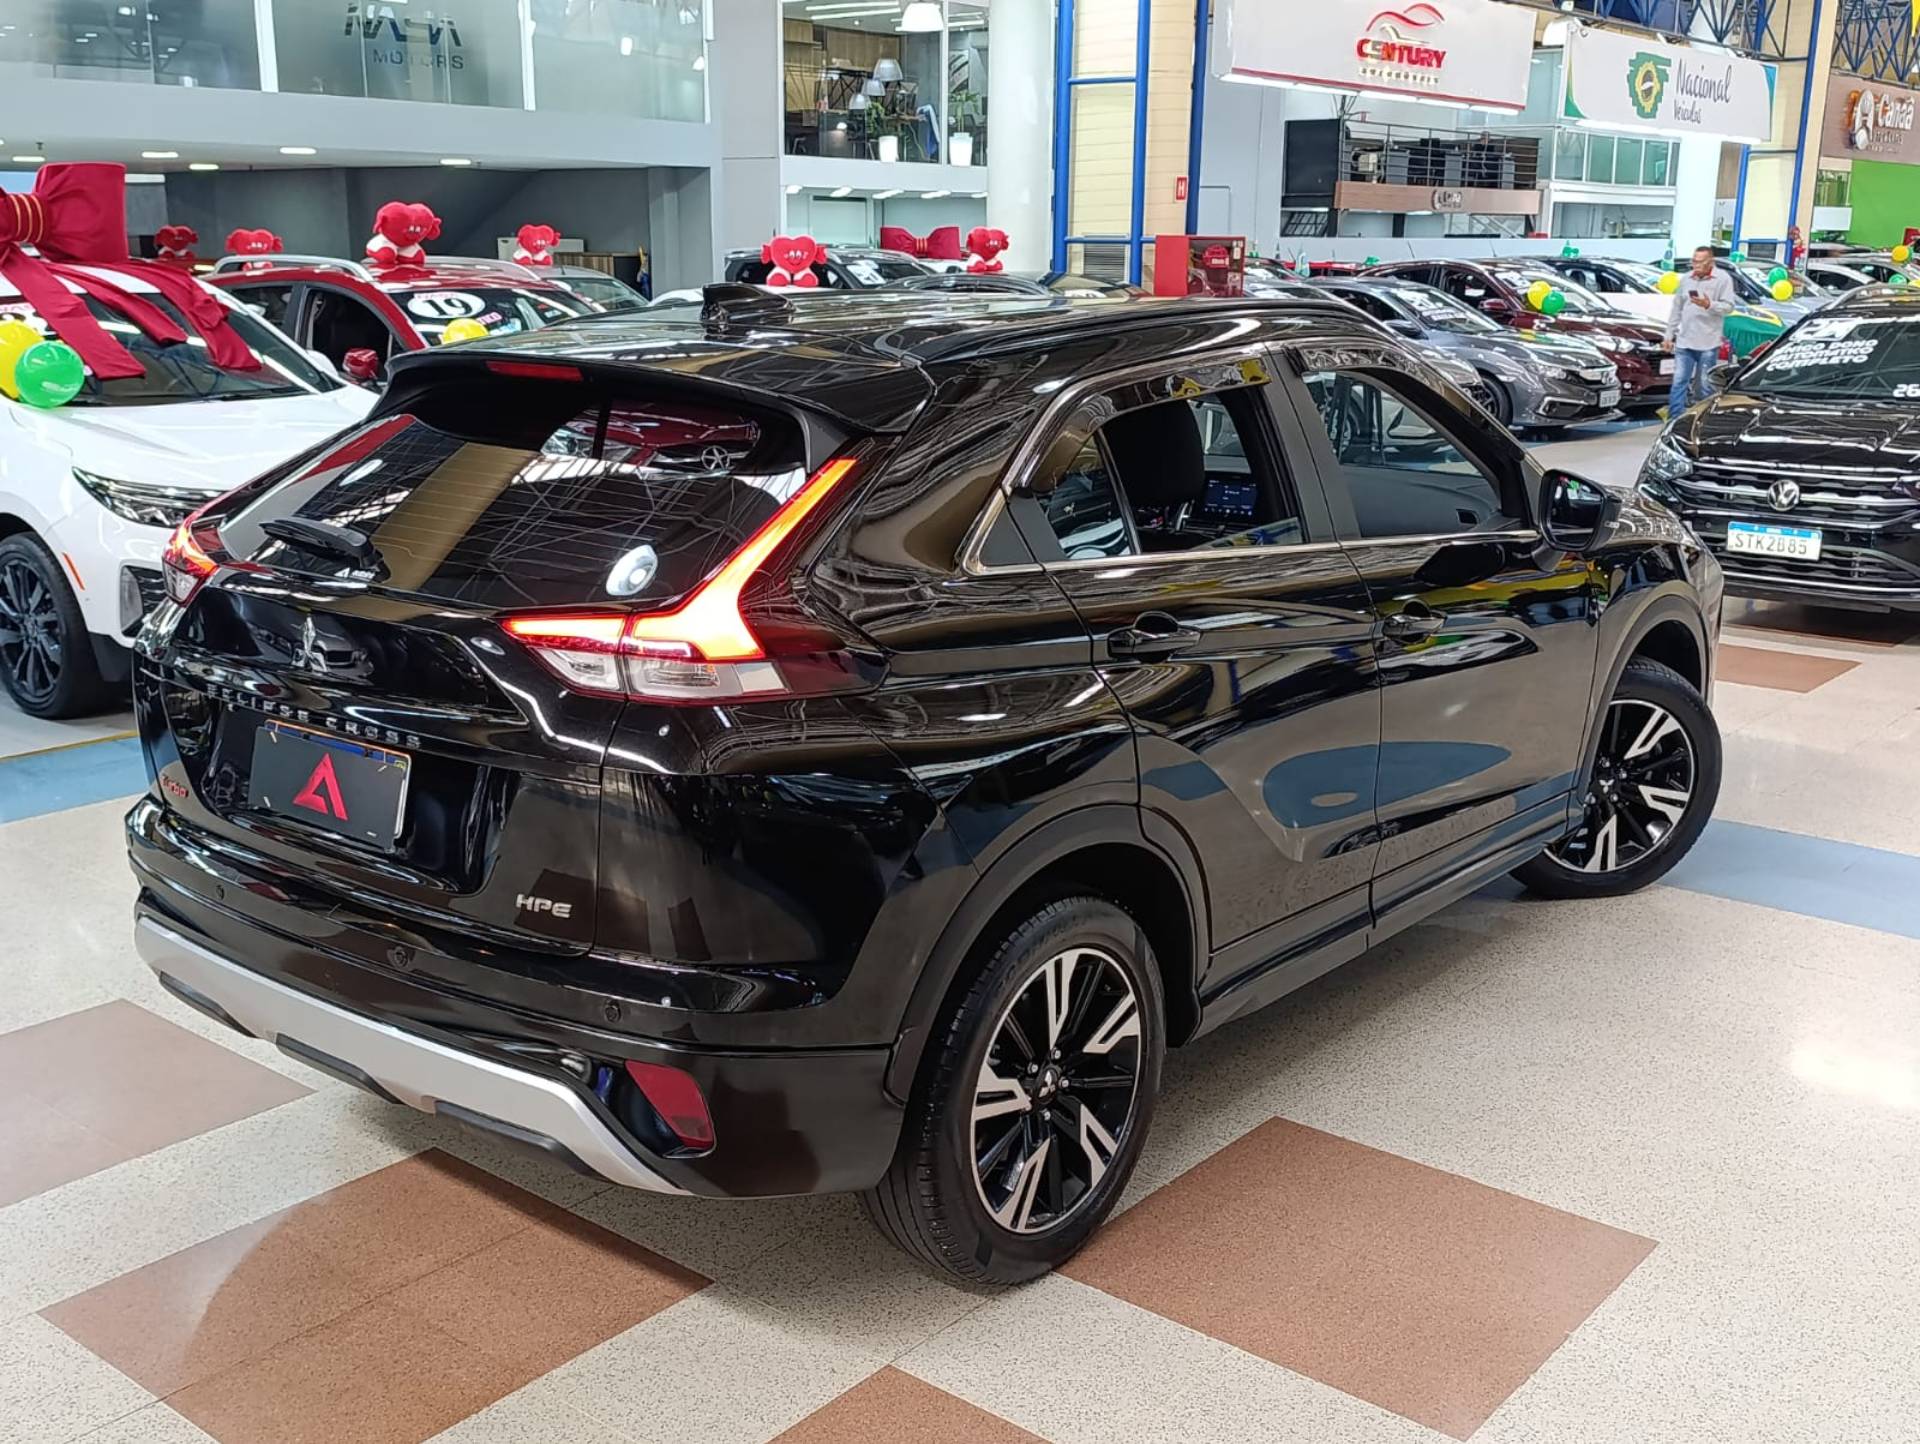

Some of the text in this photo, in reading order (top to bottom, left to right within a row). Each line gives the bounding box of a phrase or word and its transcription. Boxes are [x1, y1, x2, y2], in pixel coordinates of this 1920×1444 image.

[1356, 38, 1446, 68] CENTURY
[1676, 58, 1734, 103] Nacional
[422, 297, 474, 317] 19
[1828, 339, 1879, 351] DONO
[206, 683, 421, 750] ECLIPSE CROSS
[515, 893, 573, 918] HPE
